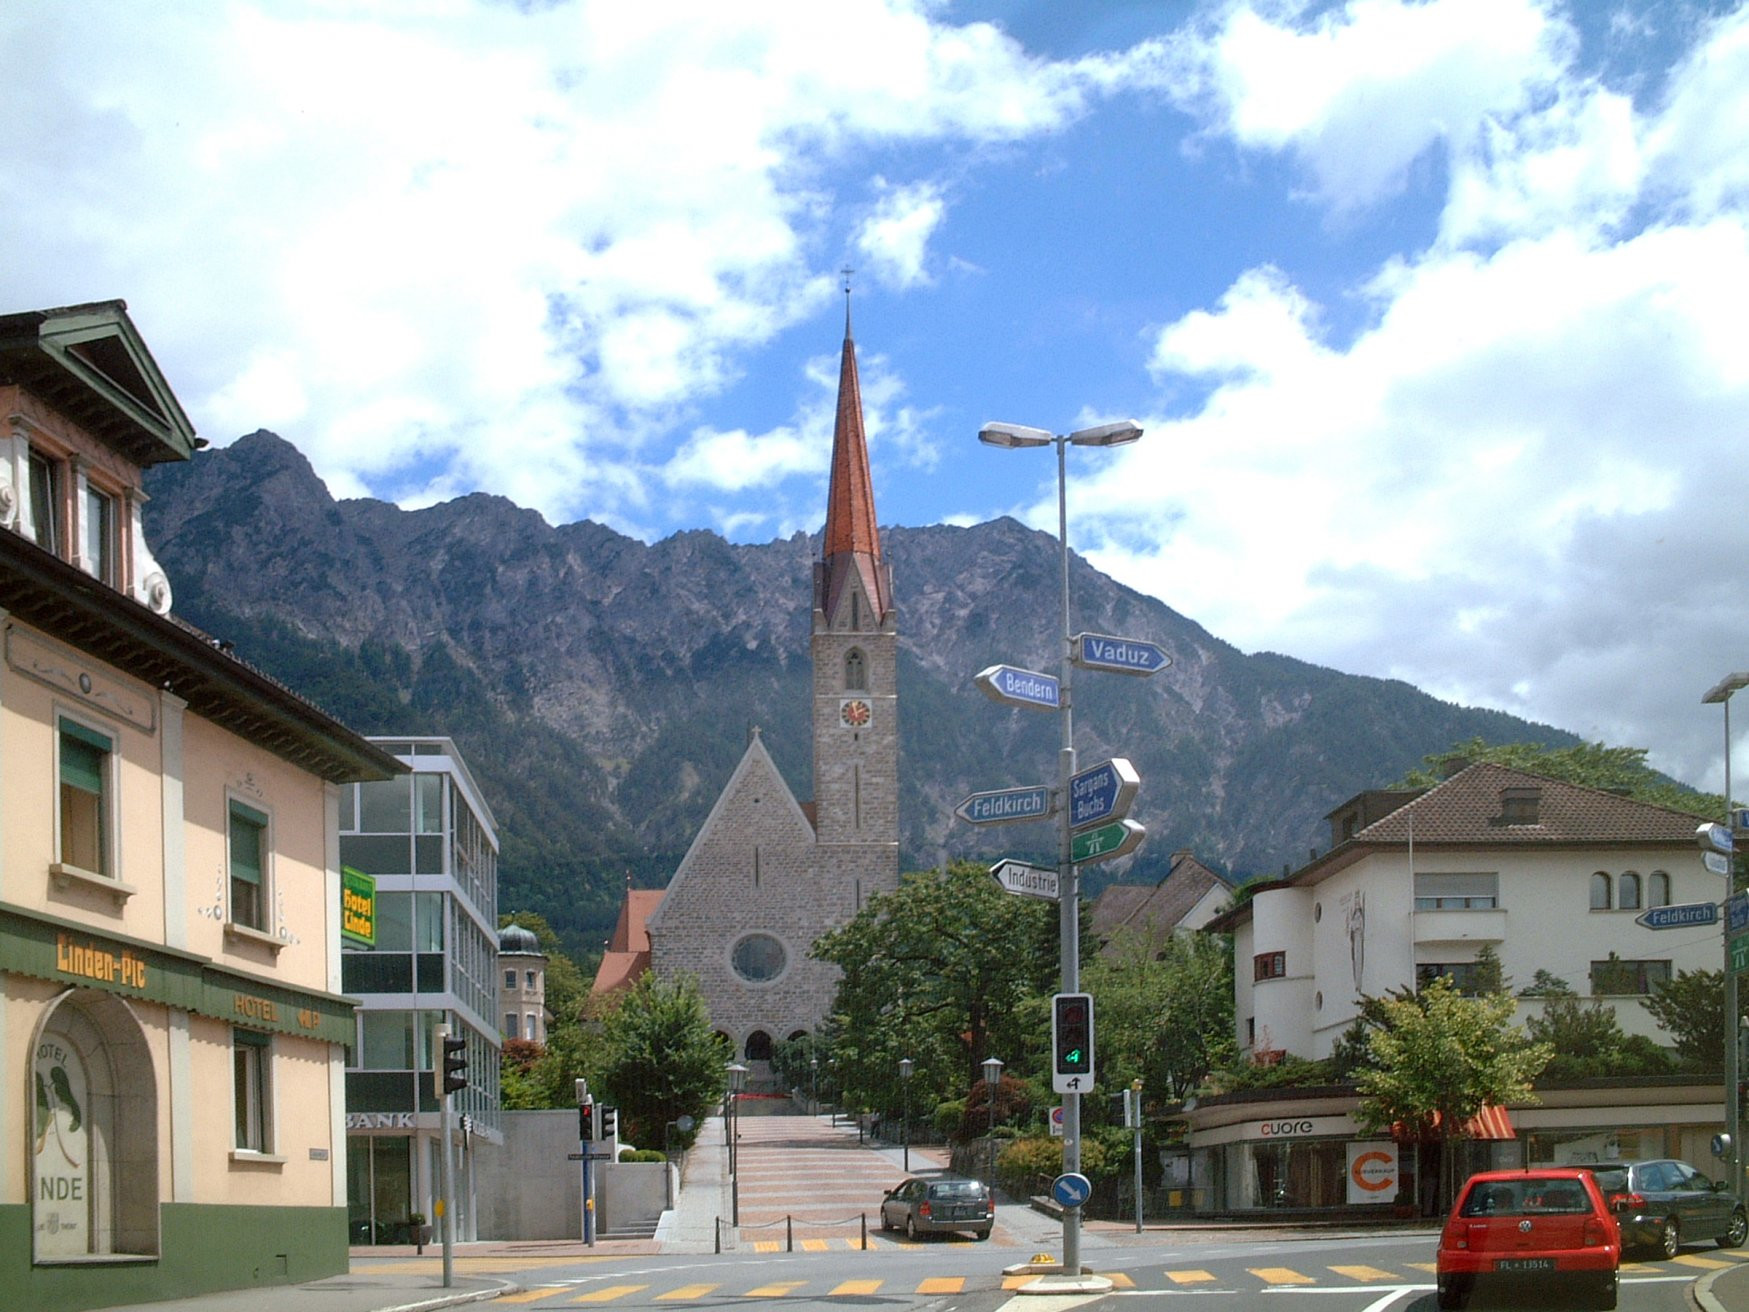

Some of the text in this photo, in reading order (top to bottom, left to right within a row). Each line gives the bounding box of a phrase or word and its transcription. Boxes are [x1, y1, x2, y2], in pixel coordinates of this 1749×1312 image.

[1092, 640, 1150, 665] Vaduz
[1006, 673, 1053, 700] Bendern
[1073, 772, 1109, 799] Sargans
[974, 793, 1041, 817] Feldkirch
[1077, 797, 1105, 819] Buchs
[1008, 867, 1057, 893] Industrie
[344, 910, 371, 937] Linde
[1653, 907, 1711, 925] Feldkirch
[234, 994, 278, 1021] HOTEL
[1261, 1120, 1313, 1136] cuore
[1500, 1260, 1511, 1269] FL
